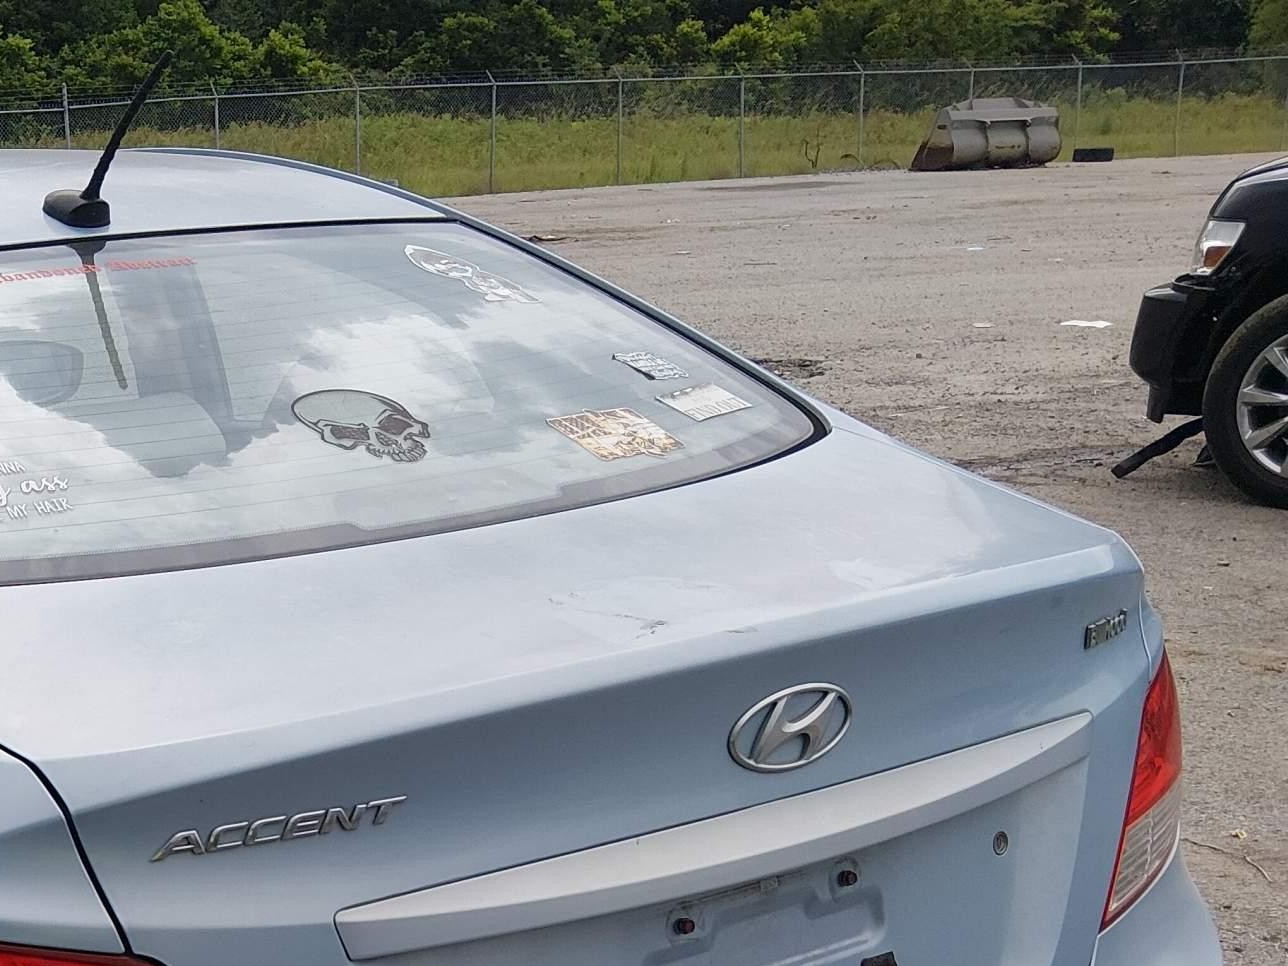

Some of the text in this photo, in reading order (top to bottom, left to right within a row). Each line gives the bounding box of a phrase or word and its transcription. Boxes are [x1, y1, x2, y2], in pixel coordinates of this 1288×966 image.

[20, 476, 69, 493] ass
[6, 503, 31, 520] MY
[34, 497, 74, 515] HAIR
[150, 795, 408, 863] ACCENT
